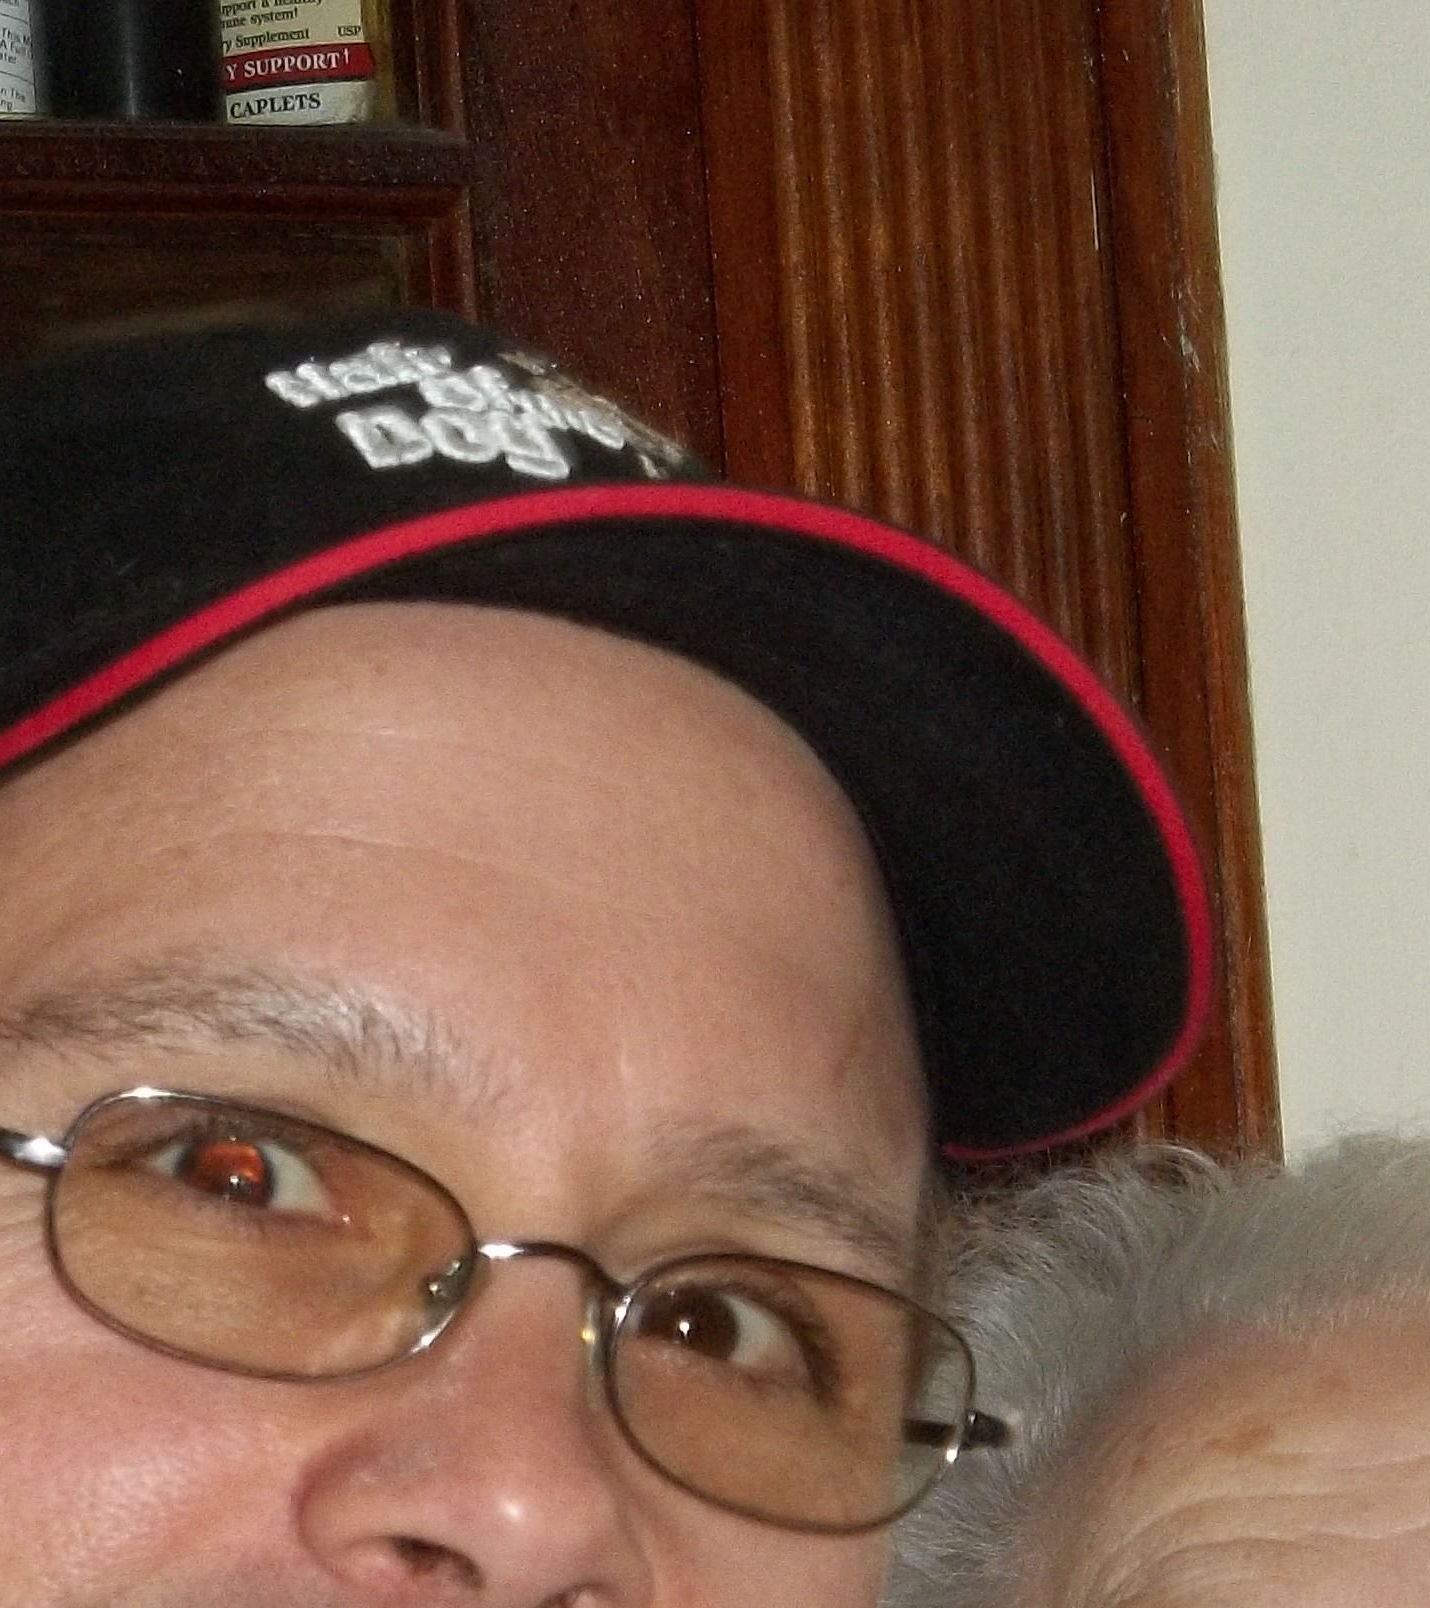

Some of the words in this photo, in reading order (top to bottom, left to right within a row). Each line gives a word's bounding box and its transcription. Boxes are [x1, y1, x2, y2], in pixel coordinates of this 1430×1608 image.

[235, 29, 309, 48] Supplement
[337, 25, 362, 37] USP
[230, 92, 321, 119] CAPLETS
